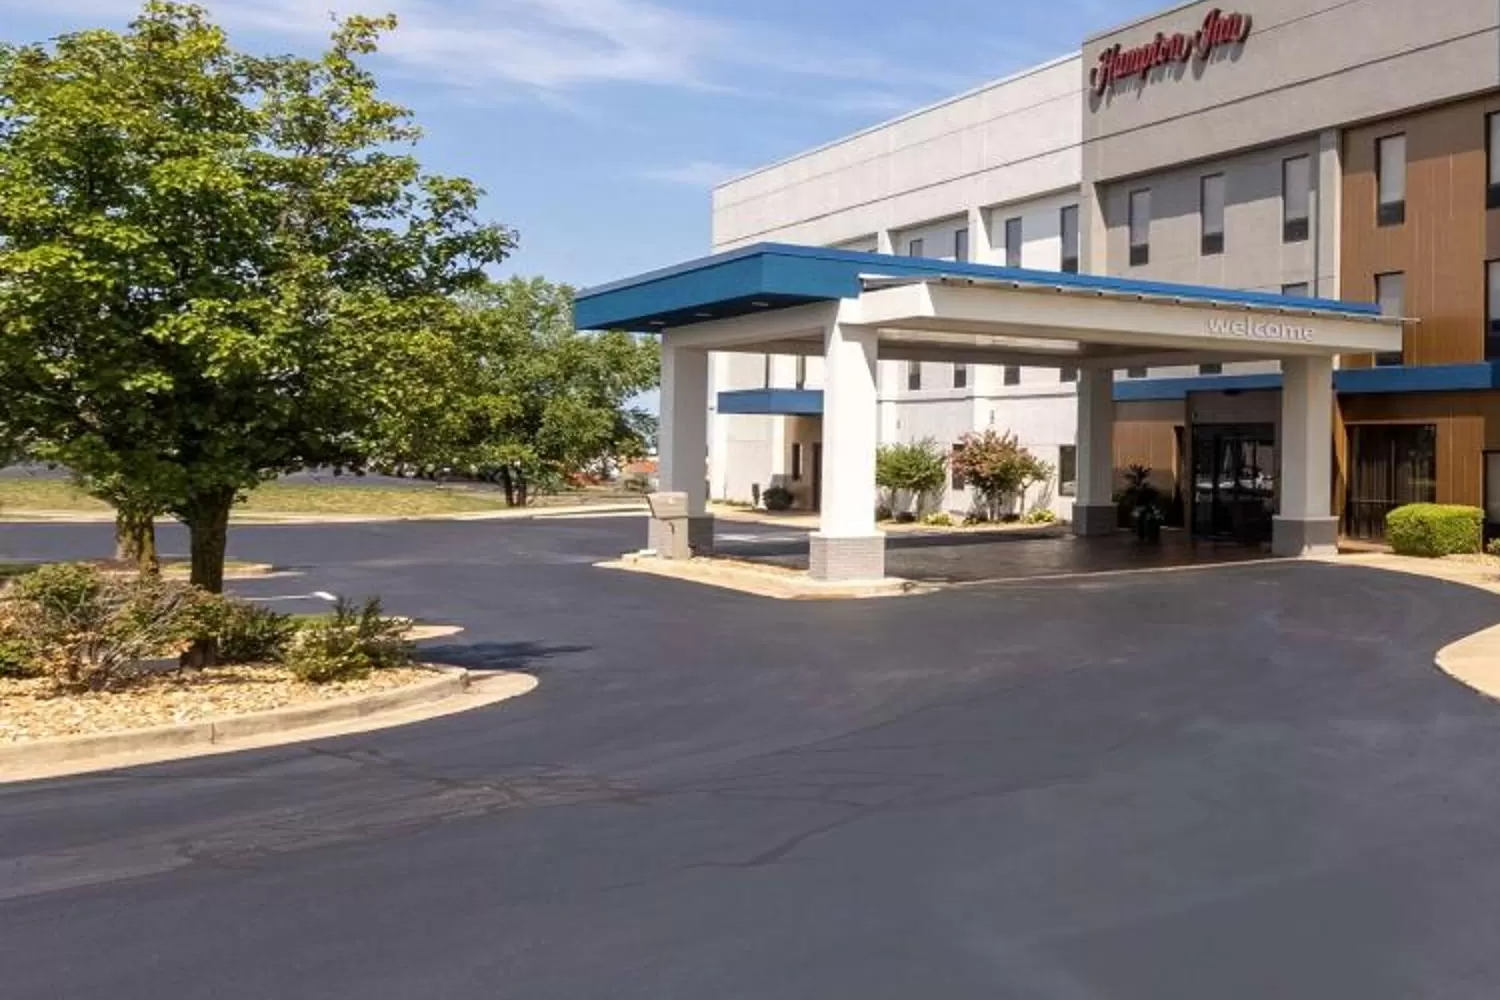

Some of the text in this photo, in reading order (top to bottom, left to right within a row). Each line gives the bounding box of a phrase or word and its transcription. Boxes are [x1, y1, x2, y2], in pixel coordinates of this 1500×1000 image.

[1089, 8, 1253, 96] Hampton Inn
[1208, 316, 1314, 342] welcome
